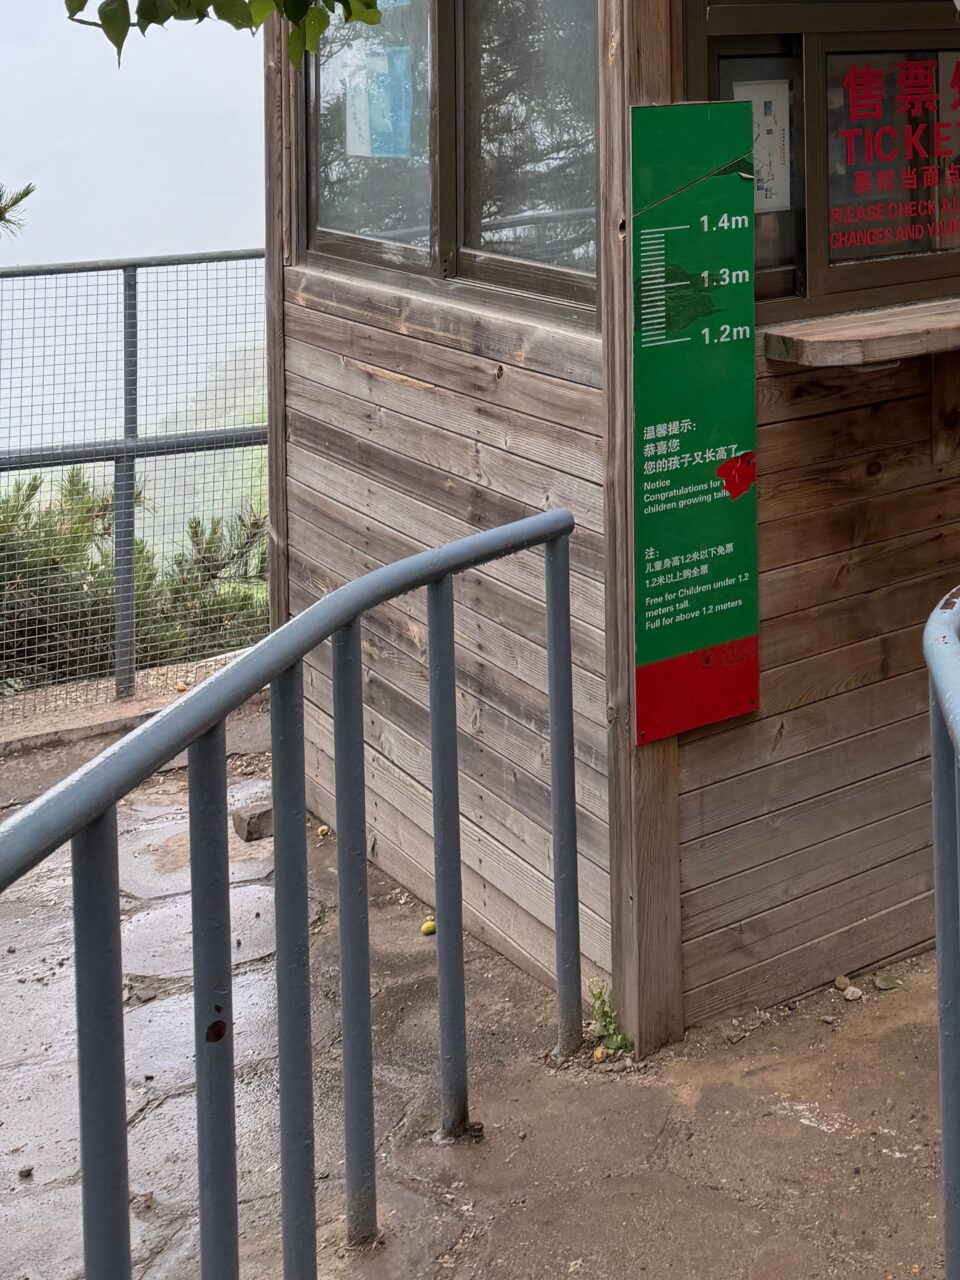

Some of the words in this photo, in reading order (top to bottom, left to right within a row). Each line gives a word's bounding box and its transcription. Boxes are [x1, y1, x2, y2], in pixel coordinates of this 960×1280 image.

[831, 203, 884, 224] PLEASE
[887, 200, 936, 219] CHECK
[701, 213, 749, 232] 1.4m
[830, 228, 893, 249] CHANGES
[896, 224, 925, 241] AND
[701, 268, 750, 288] 1.3m
[701, 325, 750, 345] 1.2m
[644, 439, 680, 457] 恭喜您
[644, 480, 671, 491] Notice
[644, 483, 708, 503] Congratulations
[710, 480, 721, 489] for
[644, 501, 677, 515] children
[679, 494, 712, 509] growing
[645, 596, 663, 606] Free
[665, 592, 677, 601] for
[678, 584, 712, 598] Children
[714, 577, 736, 588] under
[738, 573, 750, 583] 1.2
[645, 604, 674, 619] meters
[676, 600, 691, 609] tall.
[645, 619, 661, 630] Full
[663, 616, 674, 626] for
[676, 610, 700, 622] above
[702, 605, 714, 615] 1.2
[715, 599, 743, 612] meters
